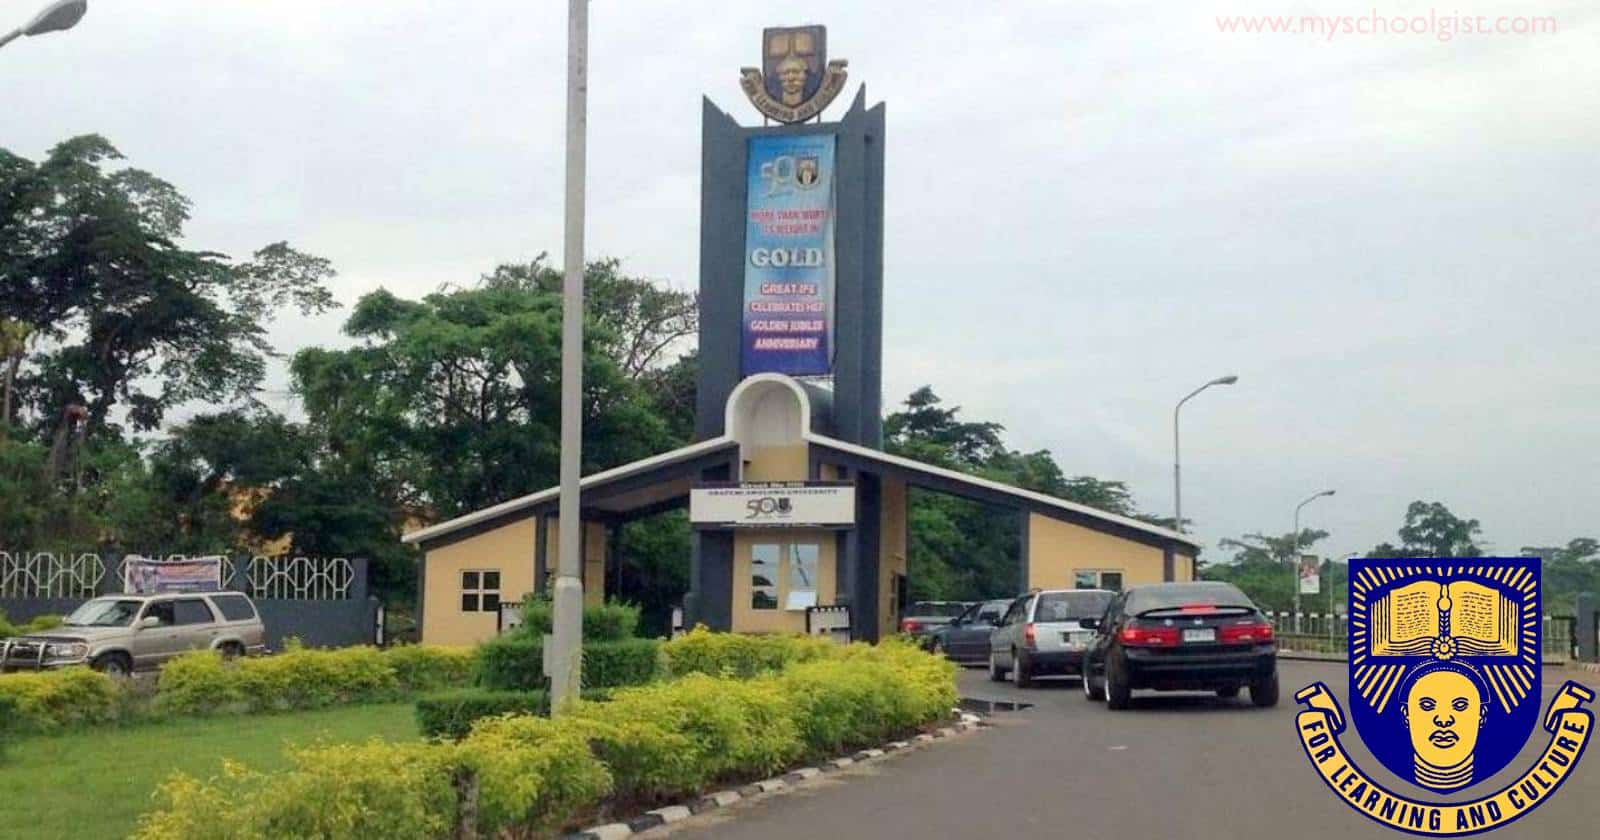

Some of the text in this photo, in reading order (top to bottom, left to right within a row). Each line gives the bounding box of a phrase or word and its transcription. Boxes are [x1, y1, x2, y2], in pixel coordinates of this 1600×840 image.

[751, 247, 824, 268] GOLD
[761, 283, 797, 294] GREAT
[751, 320, 788, 332] GOLDEN
[754, 338, 819, 350] ANNIVERSARY
